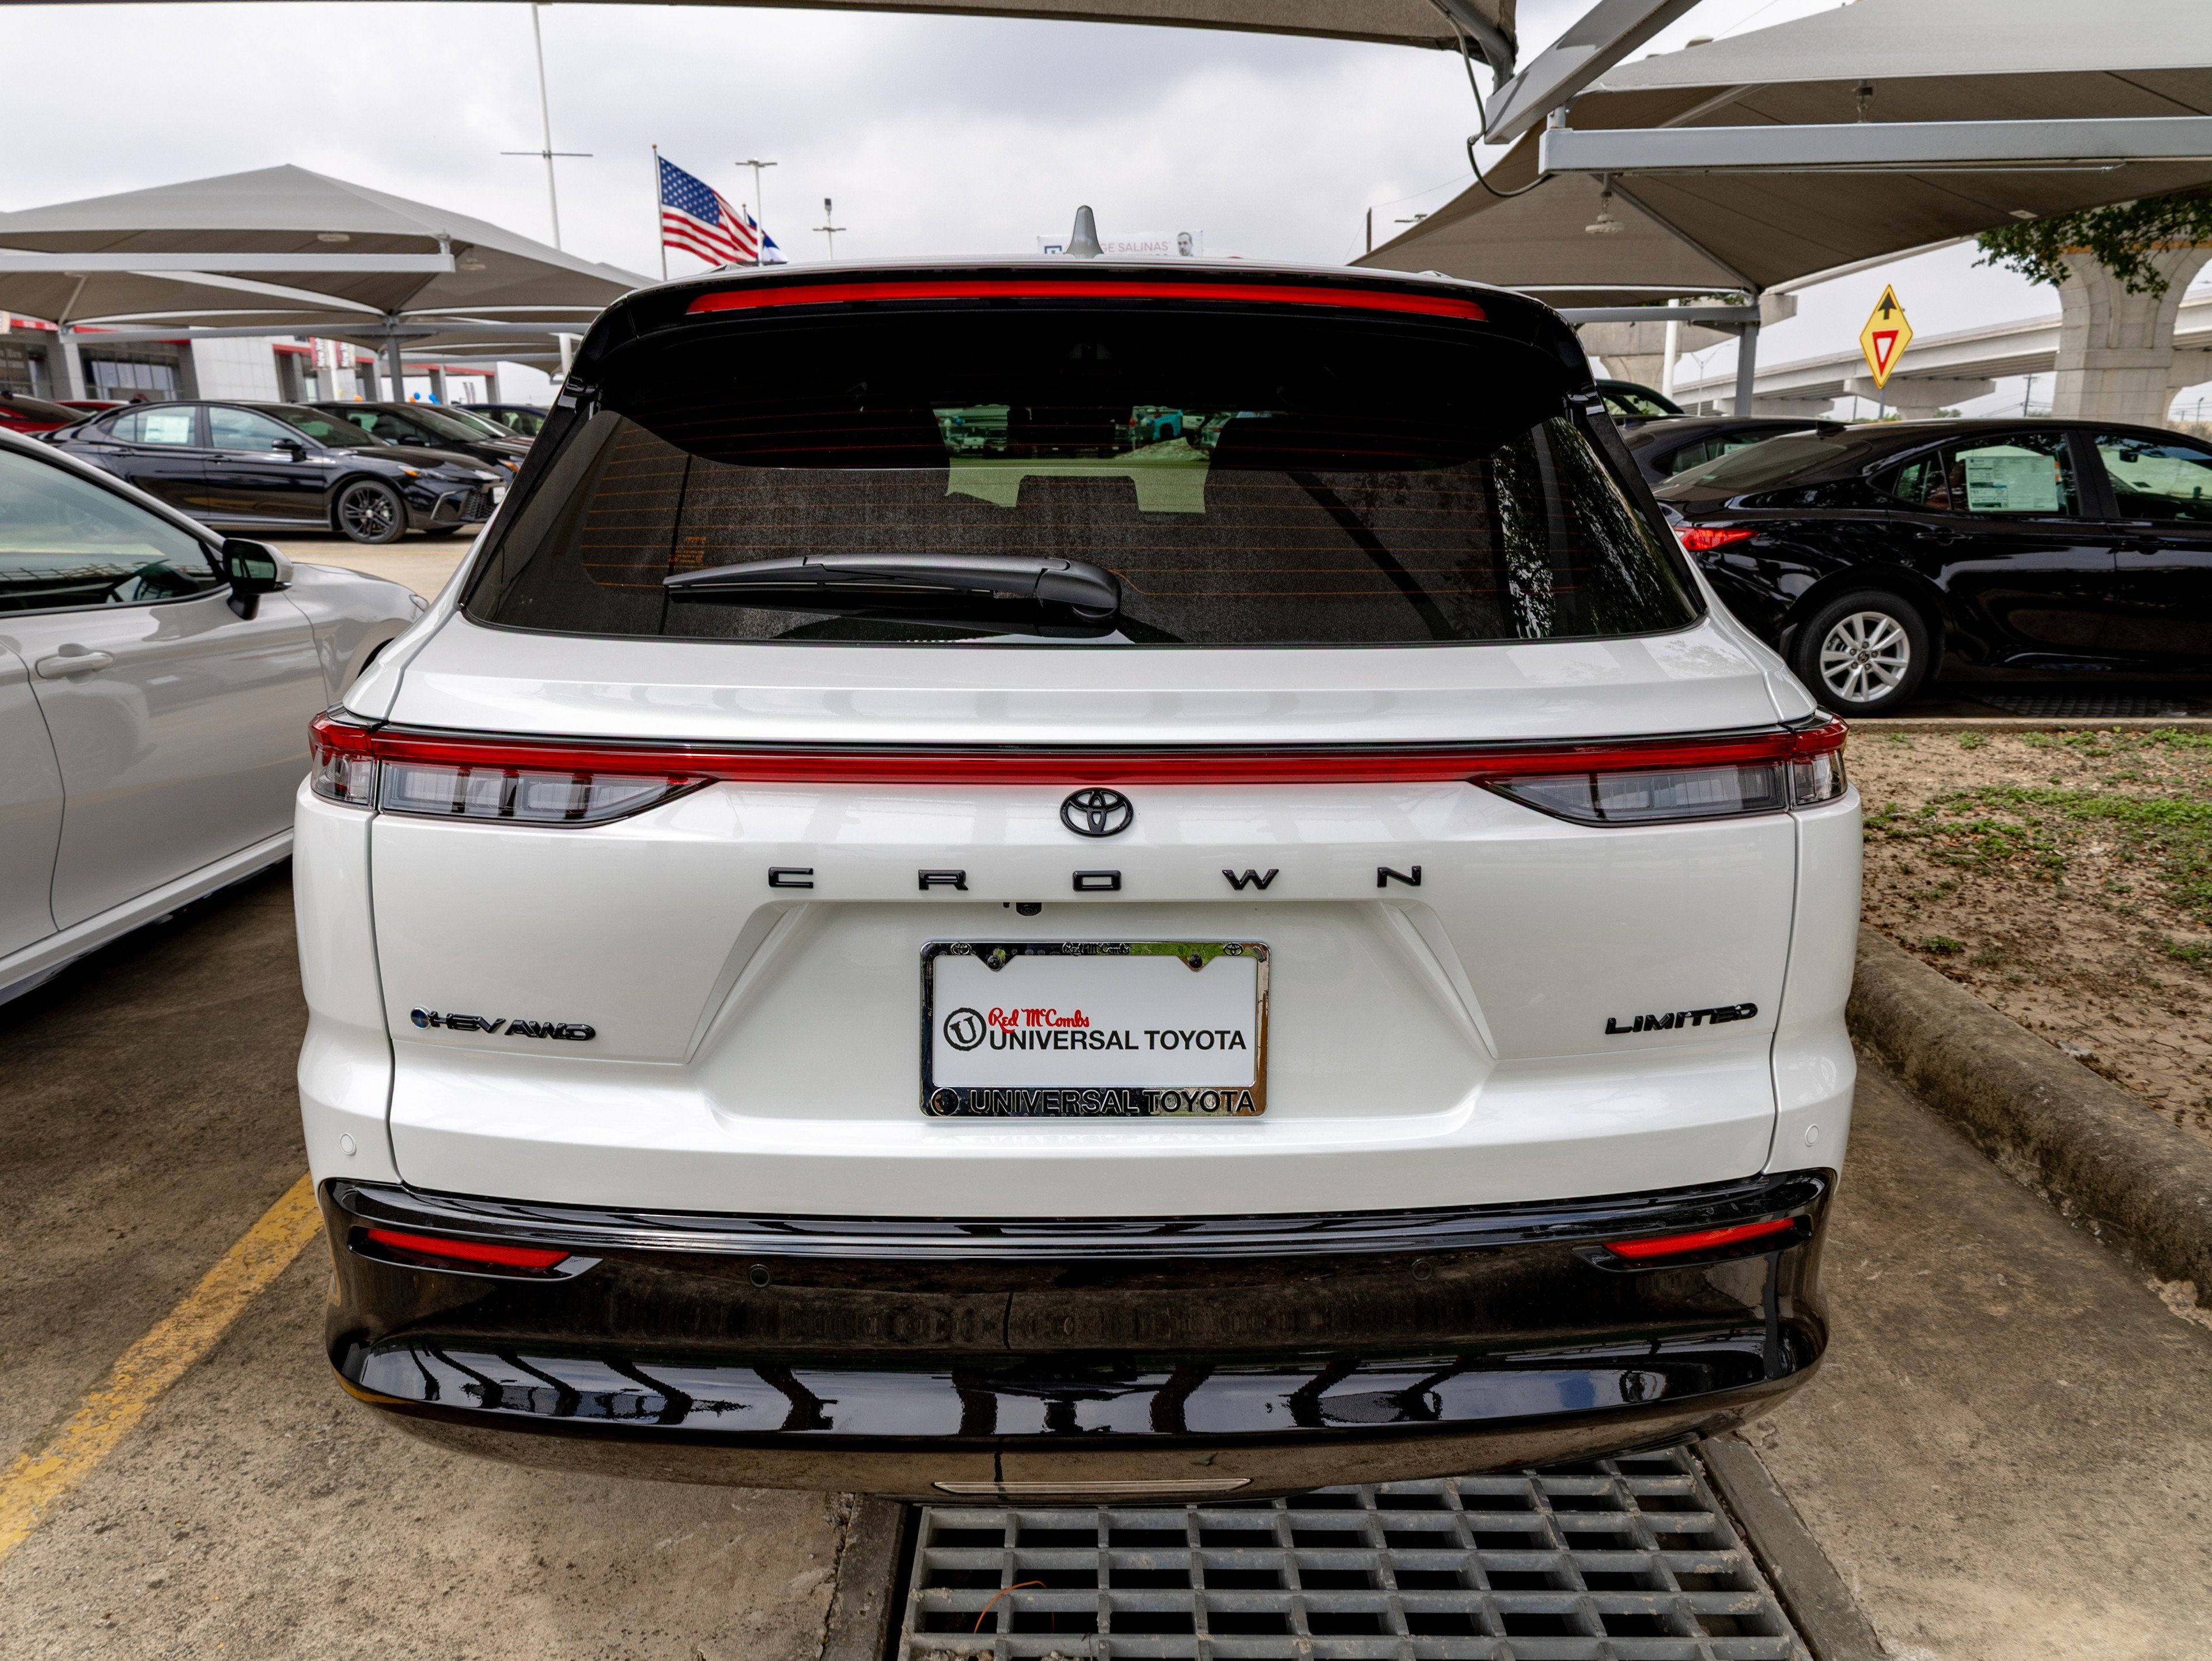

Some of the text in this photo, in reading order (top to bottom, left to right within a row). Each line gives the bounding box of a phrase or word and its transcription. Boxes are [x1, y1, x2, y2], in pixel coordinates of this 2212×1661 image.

[1118, 241, 1169, 252] SALINAS
[768, 864, 1422, 893] CROWN
[503, 1019, 597, 1041] AWD
[988, 1007, 1090, 1034] Red McCombs
[1604, 1002, 1759, 1035] LIMITED
[990, 1030, 1247, 1050] UNIVERSAL TOYOTA
[970, 1089, 1140, 1114] UNIVERSAL
[1142, 1089, 1257, 1113] TOYOTA
